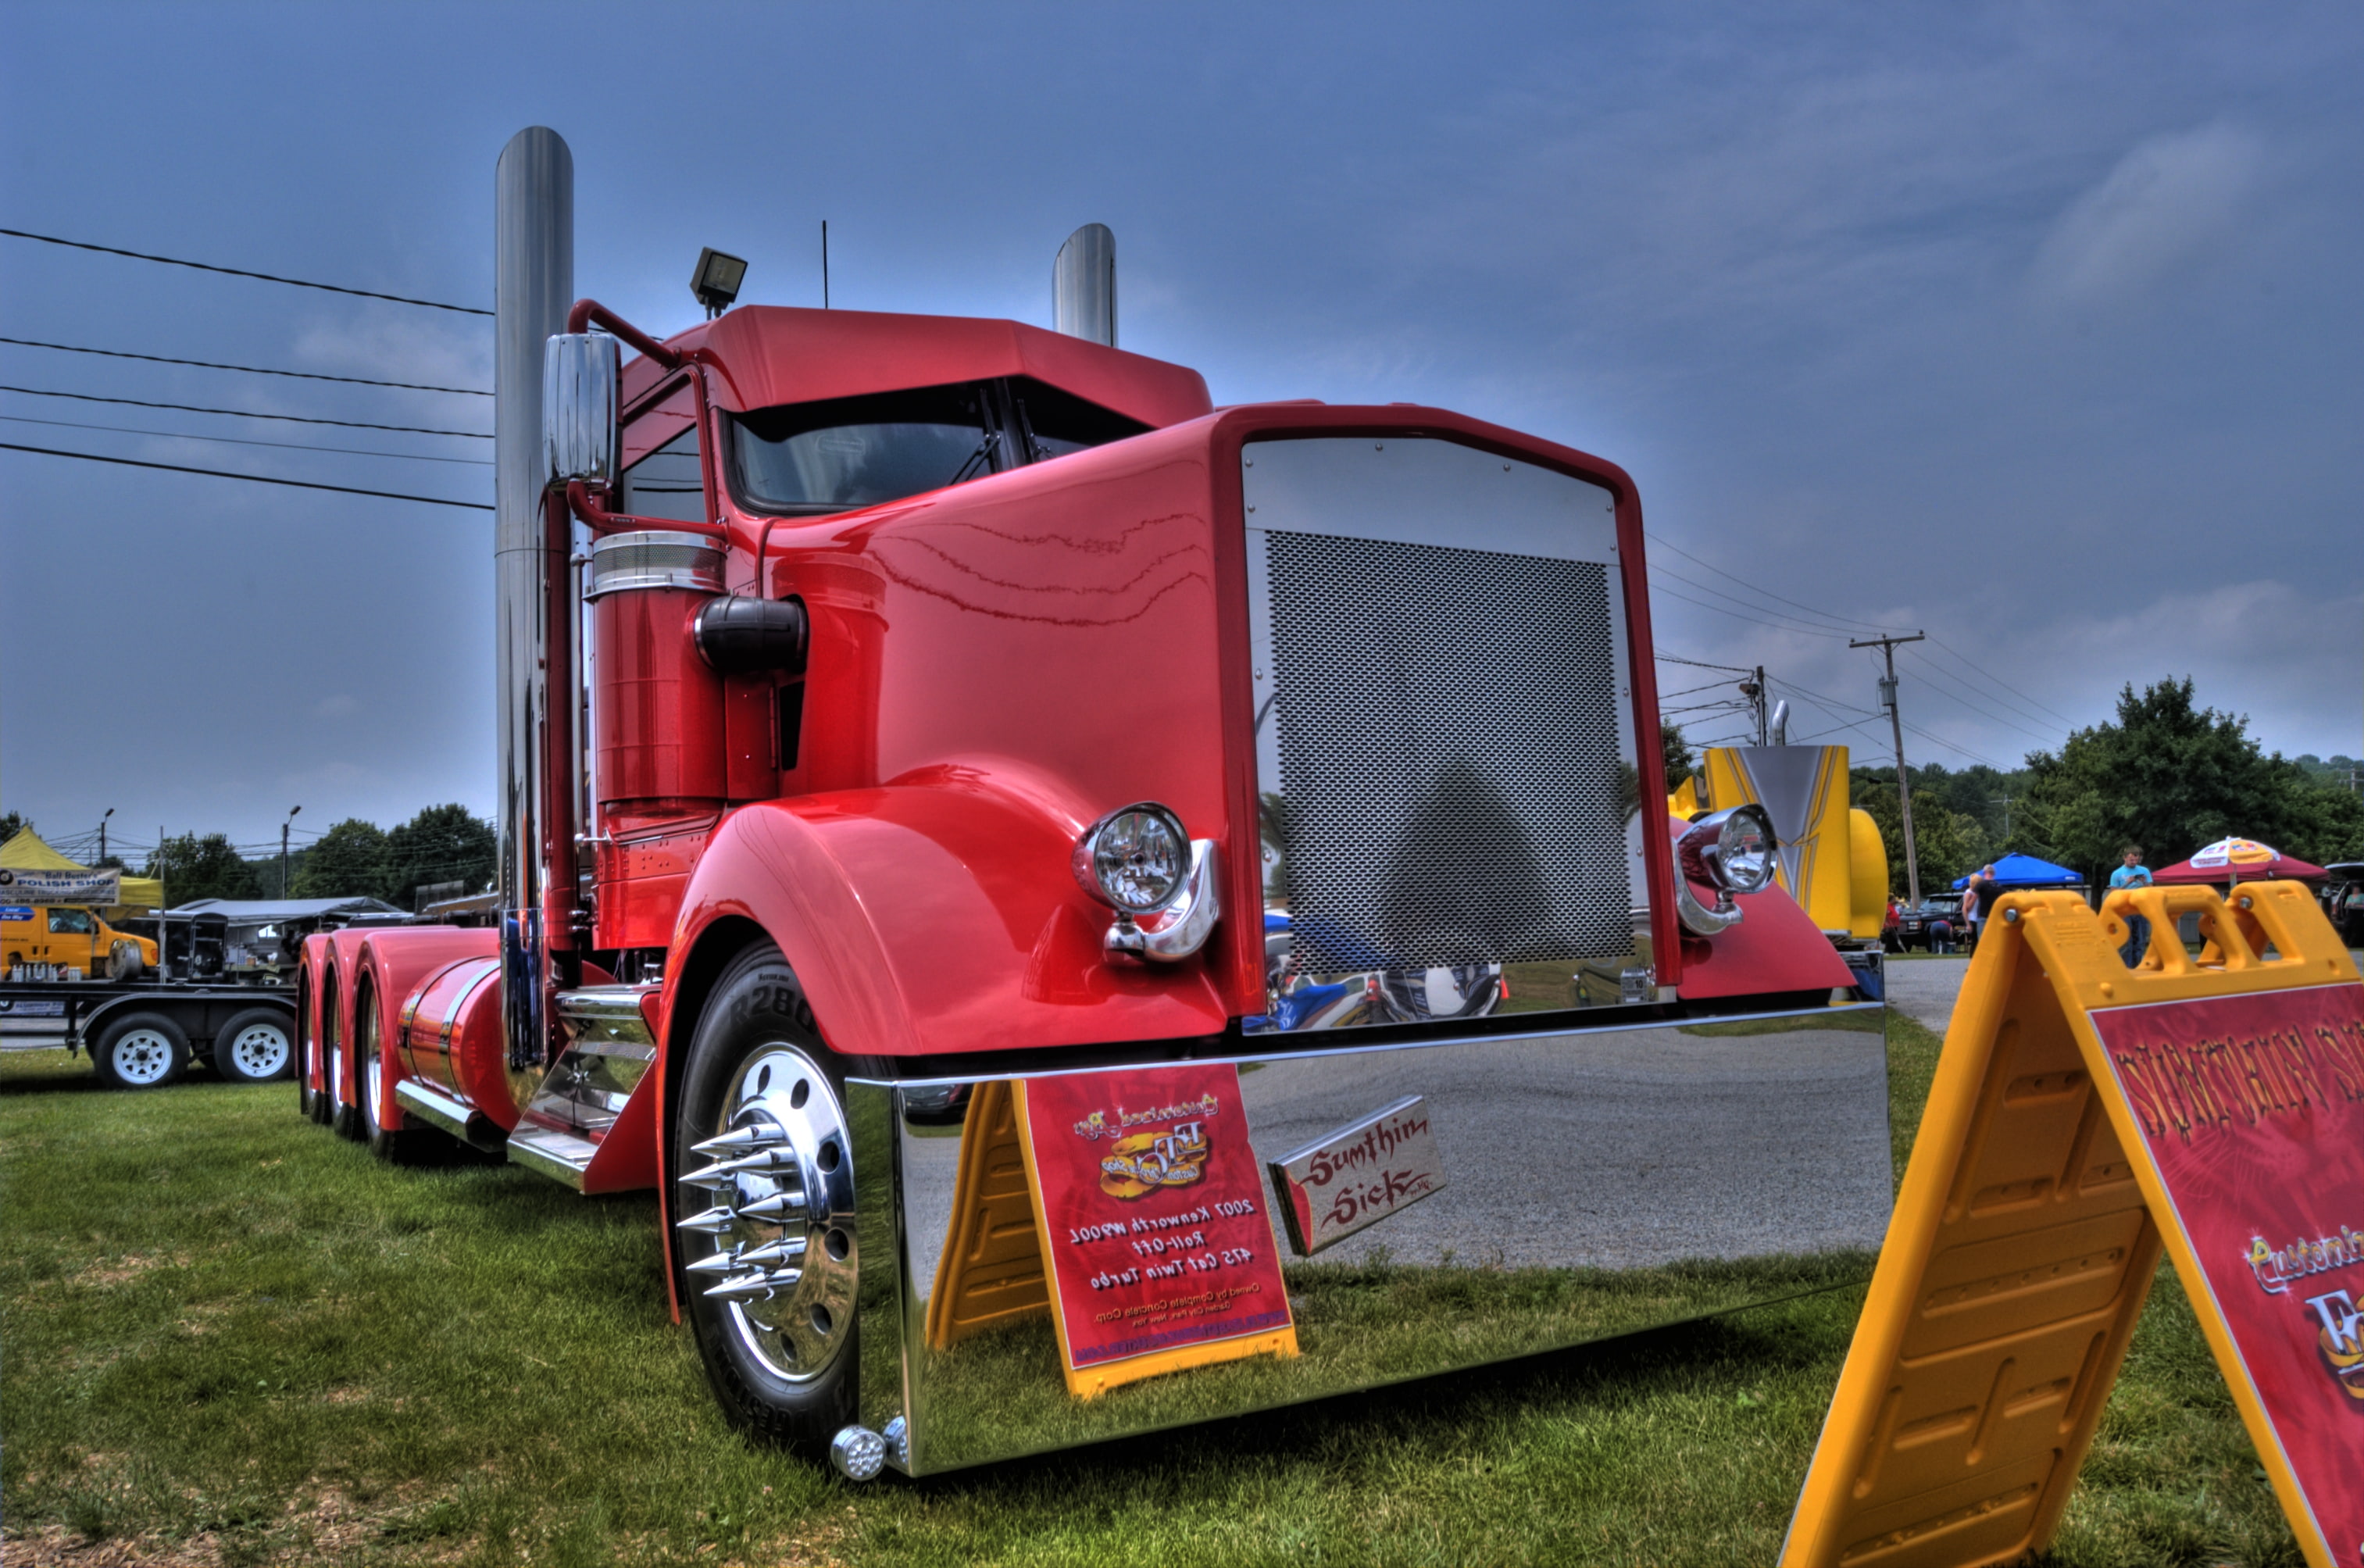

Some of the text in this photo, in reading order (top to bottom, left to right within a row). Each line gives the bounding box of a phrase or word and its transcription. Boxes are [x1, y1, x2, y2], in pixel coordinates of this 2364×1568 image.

[1635, 979, 1644, 989] 10
[1298, 1117, 1427, 1187] Sumthin
[1320, 1169, 1431, 1229] Sick
